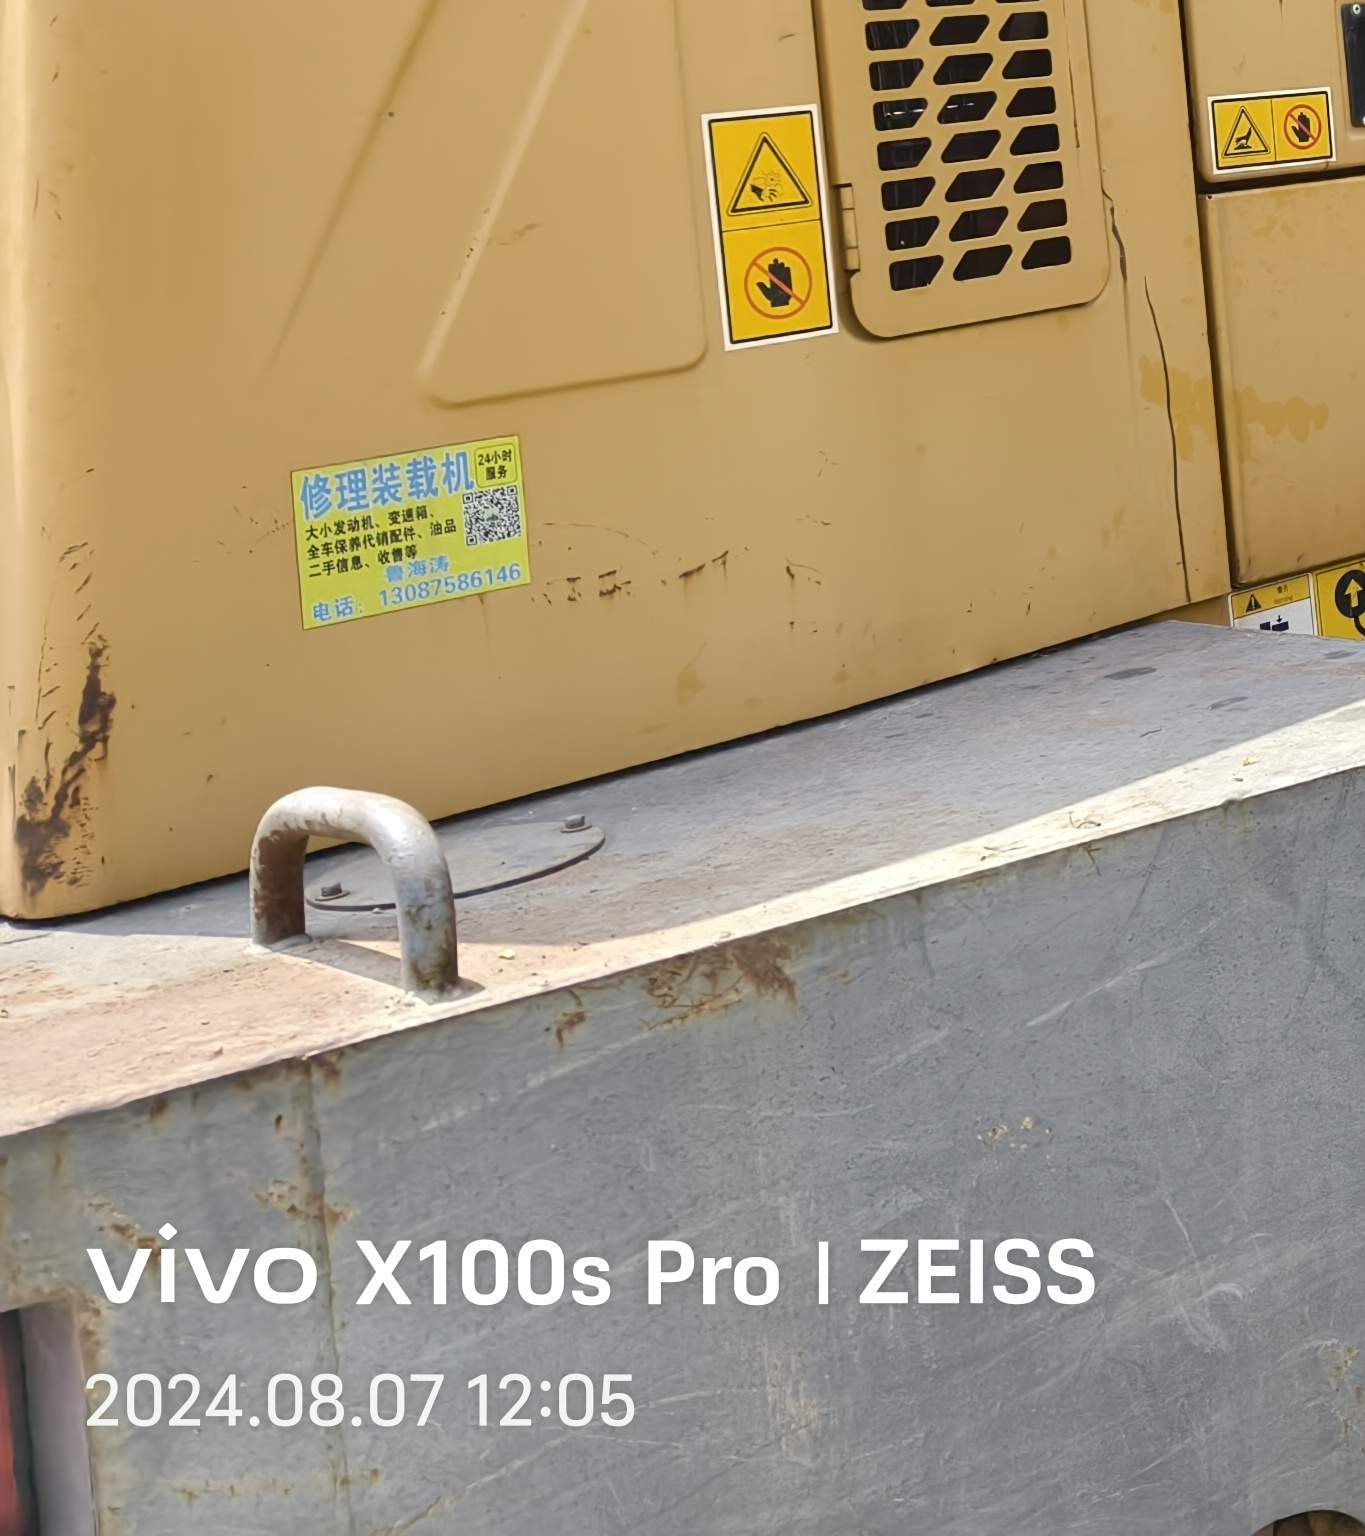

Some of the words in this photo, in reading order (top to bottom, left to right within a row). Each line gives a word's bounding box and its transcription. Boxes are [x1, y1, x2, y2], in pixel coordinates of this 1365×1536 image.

[477, 448, 513, 467] 24小时
[485, 465, 508, 481] 服务
[300, 450, 475, 521] 修理装载机
[379, 562, 522, 608] 13087586146
